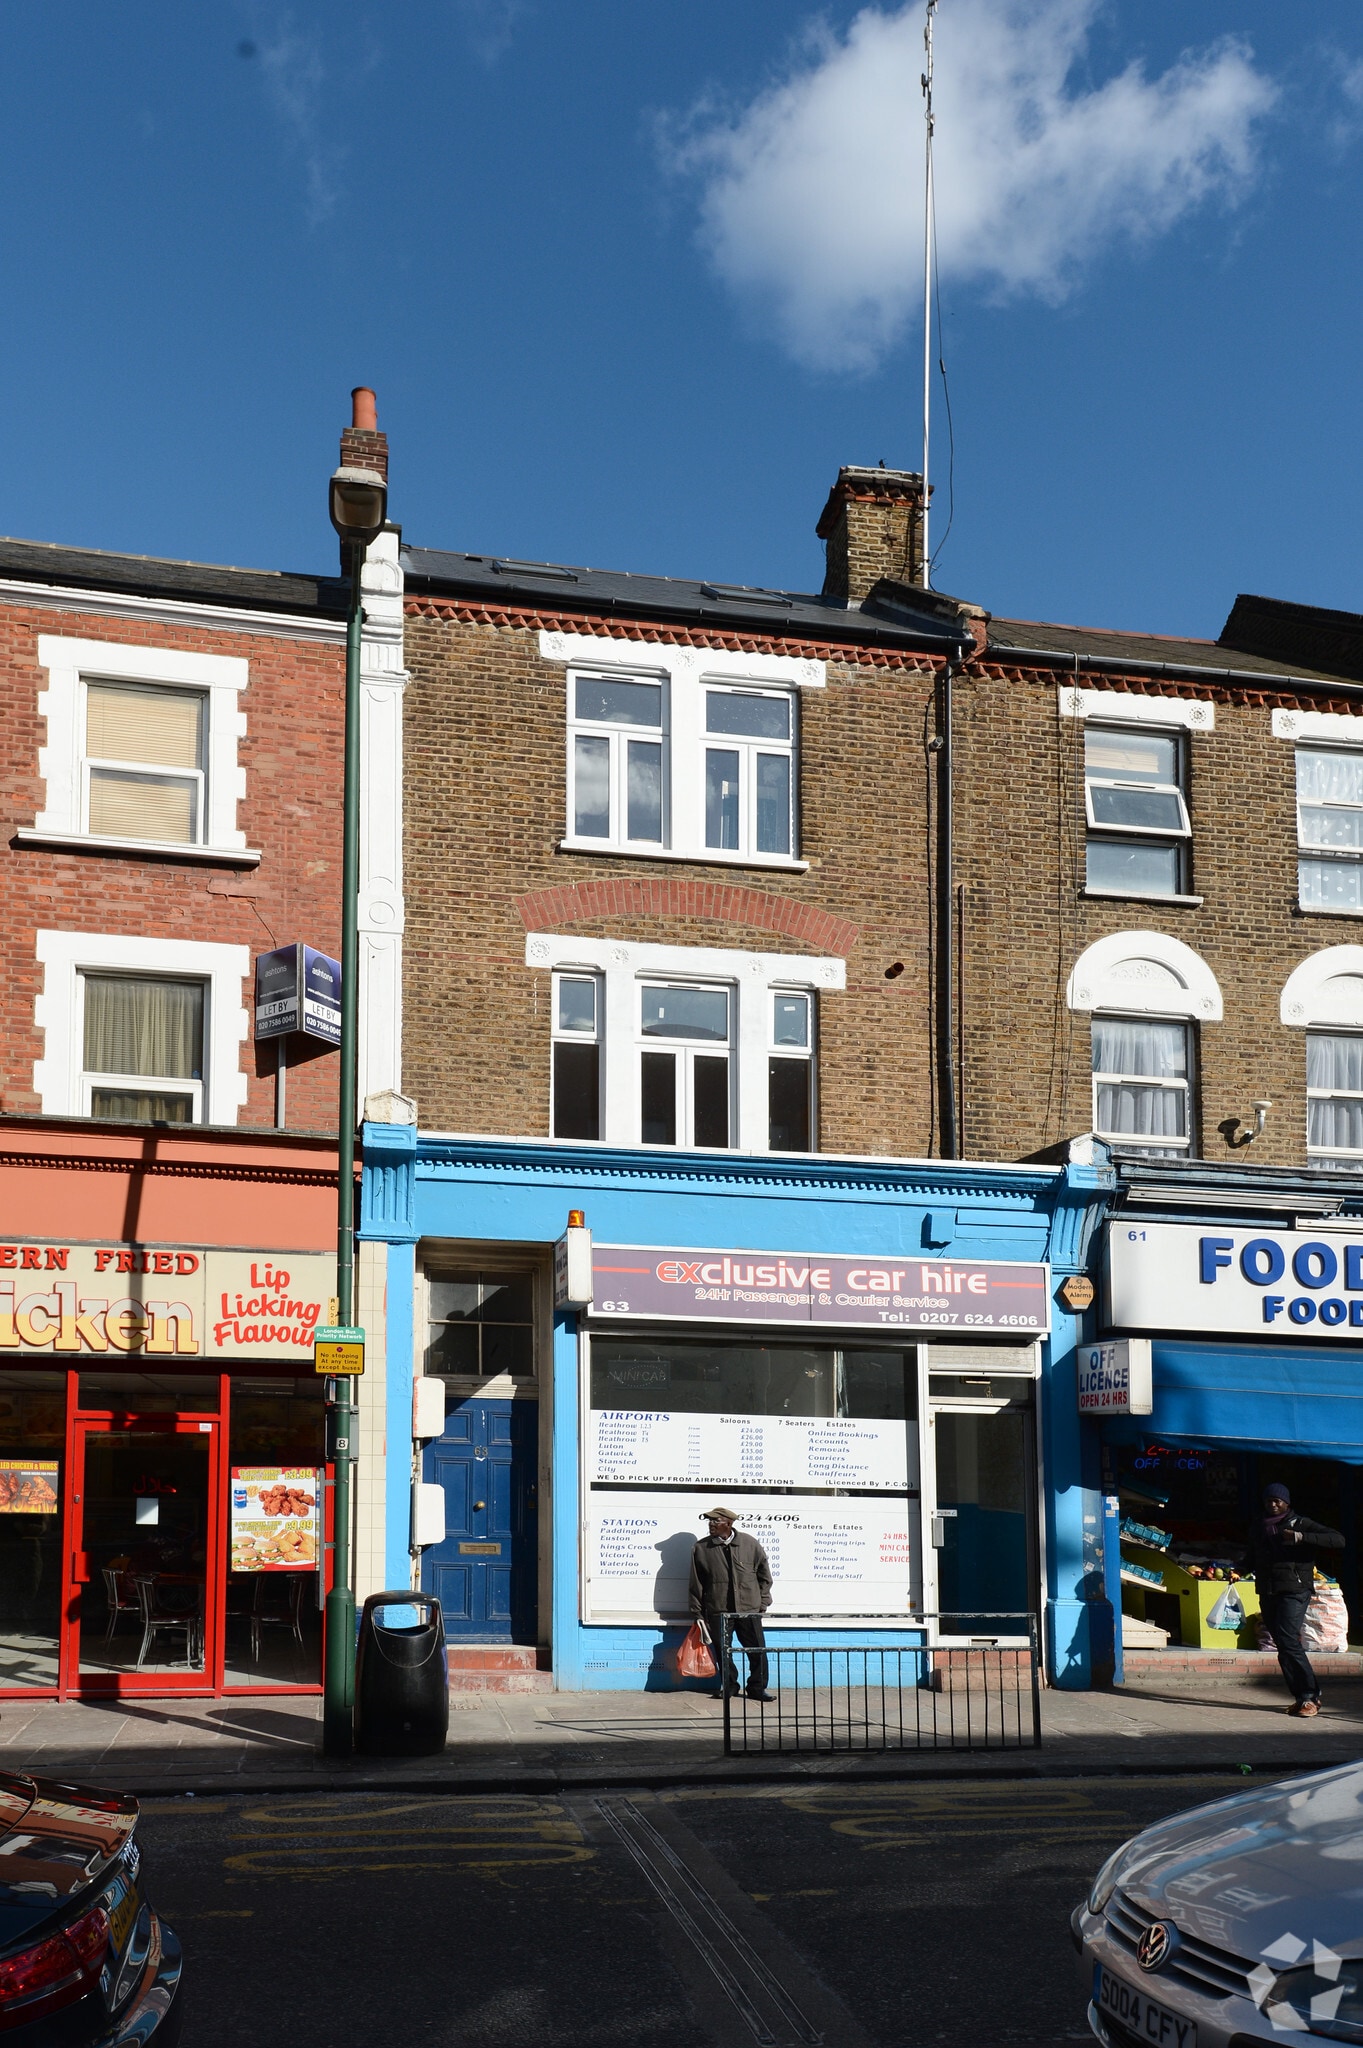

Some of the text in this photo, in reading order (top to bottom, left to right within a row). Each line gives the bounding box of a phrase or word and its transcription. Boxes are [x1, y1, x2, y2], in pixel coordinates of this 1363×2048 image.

[265, 965, 287, 977] ashtons
[312, 968, 333, 982] ashtons
[264, 1001, 288, 1016] LET BY
[313, 1004, 336, 1020] LET BY
[258, 1020, 268, 1030] 020
[1128, 1231, 1146, 1241] 61
[95, 1250, 199, 1275] FRIED
[251, 1263, 290, 1294] Lip
[847, 1268, 906, 1292] car
[920, 1265, 988, 1295] hire
[695, 1288, 950, 1309] 24Hr Passenger & Courier Service
[221, 1293, 321, 1328] Licking
[602, 1301, 630, 1312] 63
[879, 1311, 1038, 1326] Tel: 0207 624 4606
[1090, 1349, 1115, 1370] OFF
[1080, 1368, 1128, 1392] LICENCE
[1081, 1391, 1127, 1408] OPEN 24 HRS
[600, 1412, 670, 1421] AIRPORTS
[839, 1431, 879, 1439] Bookings
[339, 1440, 345, 1448] 8
[474, 1446, 488, 1456] 63
[1134, 1457, 1160, 1469] OFF
[285, 1469, 313, 1480] £3.99
[285, 1520, 313, 1530] £9.99
[1146, 2004, 1188, 2048] CFY
